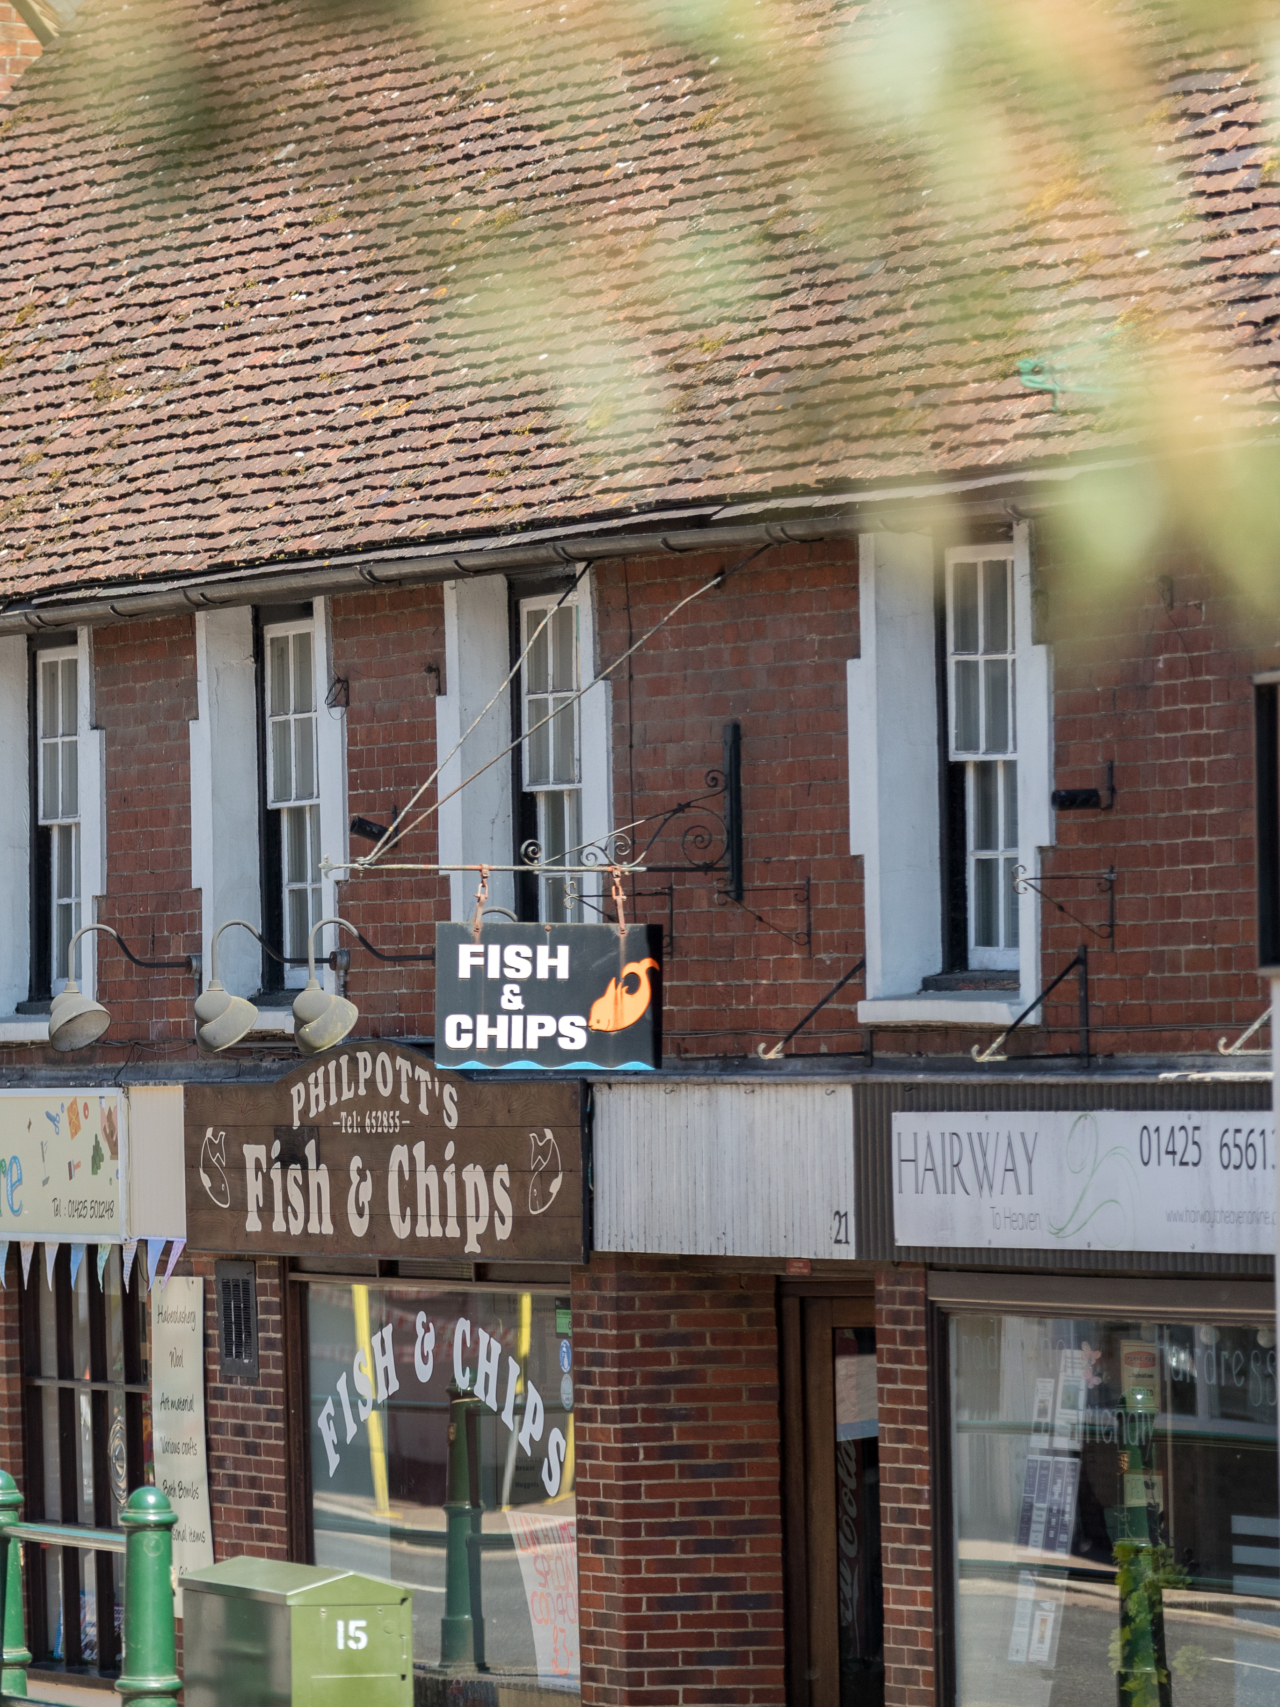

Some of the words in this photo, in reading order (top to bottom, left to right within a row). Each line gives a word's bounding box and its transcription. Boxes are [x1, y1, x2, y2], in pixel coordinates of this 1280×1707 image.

[457, 944, 569, 980] FISH
[500, 984, 525, 1011] &
[444, 1015, 588, 1050] CHIPS
[290, 1051, 459, 1130] PHILPOTT'S
[896, 1130, 1038, 1198] HAIRWAY
[1139, 1125, 1203, 1167] 01425
[1219, 1128, 1276, 1171] 6561
[68, 1199, 88, 1219] 01425
[89, 1199, 115, 1220] 501248
[243, 1139, 334, 1236] Fish
[347, 1155, 373, 1237] &
[388, 1140, 513, 1254] Chips
[833, 1210, 850, 1245] 21
[990, 1206, 1001, 1230] To
[1004, 1206, 1041, 1231] Heaven
[157, 1304, 197, 1332] Haberdashery
[169, 1347, 184, 1369] Wool
[1155, 1325, 1277, 1407] Hairdress
[160, 1392, 170, 1412] Art
[170, 1393, 195, 1413] material
[317, 1323, 400, 1478] FISH
[413, 1311, 436, 1383] &
[453, 1317, 567, 1497] CHIPS
[160, 1436, 180, 1456] Various
[181, 1437, 198, 1456] crafts
[162, 1479, 177, 1498] Bath
[177, 1480, 200, 1500] Bombs
[172, 1523, 188, 1543] sonal
[188, 1527, 206, 1544] items
[336, 1619, 368, 1650] 15
